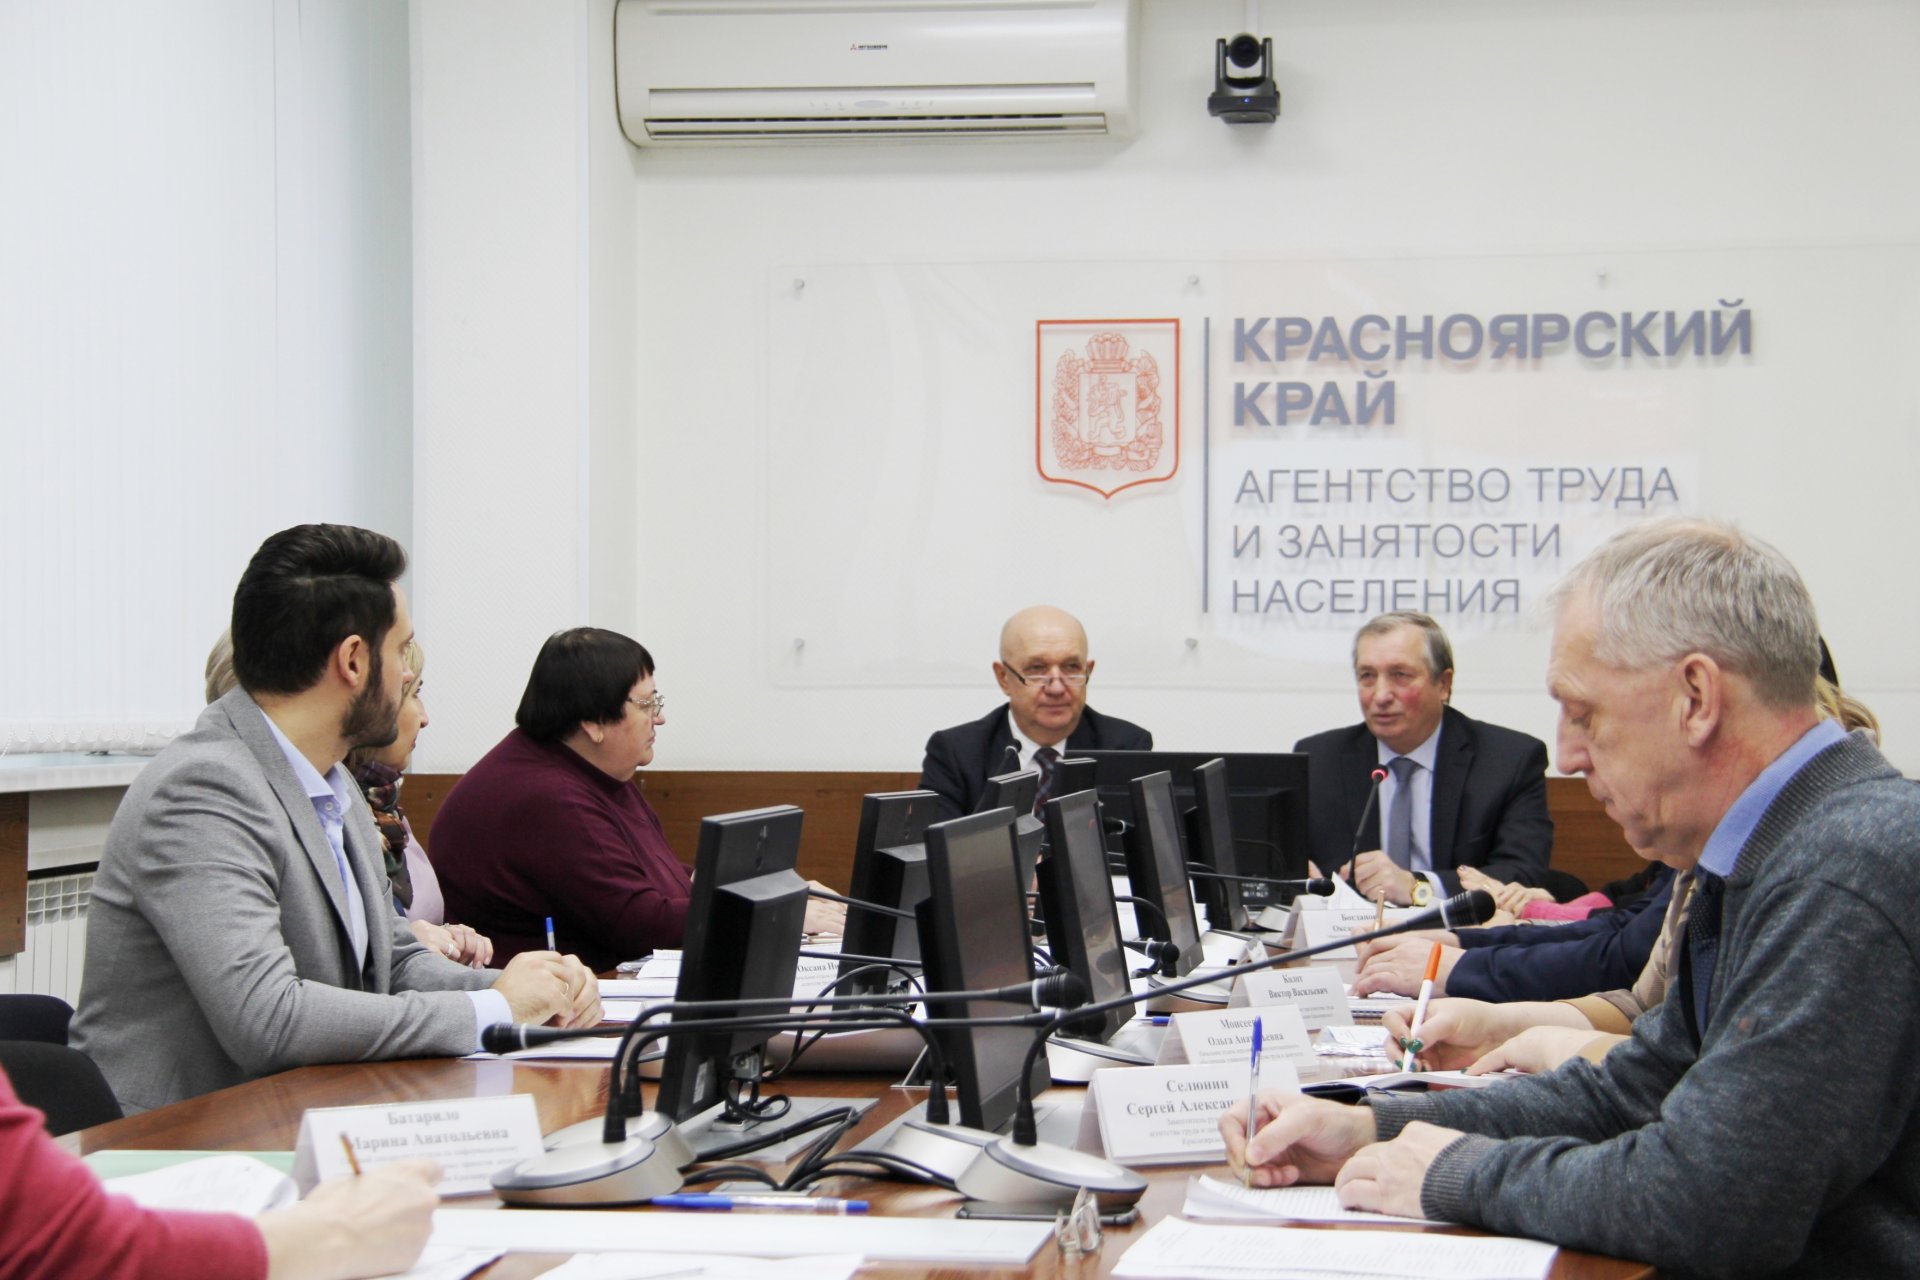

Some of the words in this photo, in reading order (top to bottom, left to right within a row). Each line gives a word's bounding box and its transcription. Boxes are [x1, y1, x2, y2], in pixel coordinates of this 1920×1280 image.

[1233, 298, 1752, 363] КРАСНОЯРСКИЙ
[1233, 369, 1396, 427] КРАЙ
[1235, 467, 1511, 504] АГЕНТСТВО
[1527, 466, 1679, 509] ТРУДА
[1233, 525, 1260, 559] И
[1277, 523, 1561, 559] ЗАНЯТОСТИ
[1232, 579, 1520, 614] НАСЕЛЕНИЯ
[1208, 1035, 1233, 1046] Ольга
[1235, 1033, 1284, 1045] Анатьевна
[1166, 1079, 1229, 1092] Селюнин
[387, 1110, 460, 1126] Батарило
[1126, 1100, 1175, 1118] Сергей
[414, 1129, 509, 1146] Анатольевна
